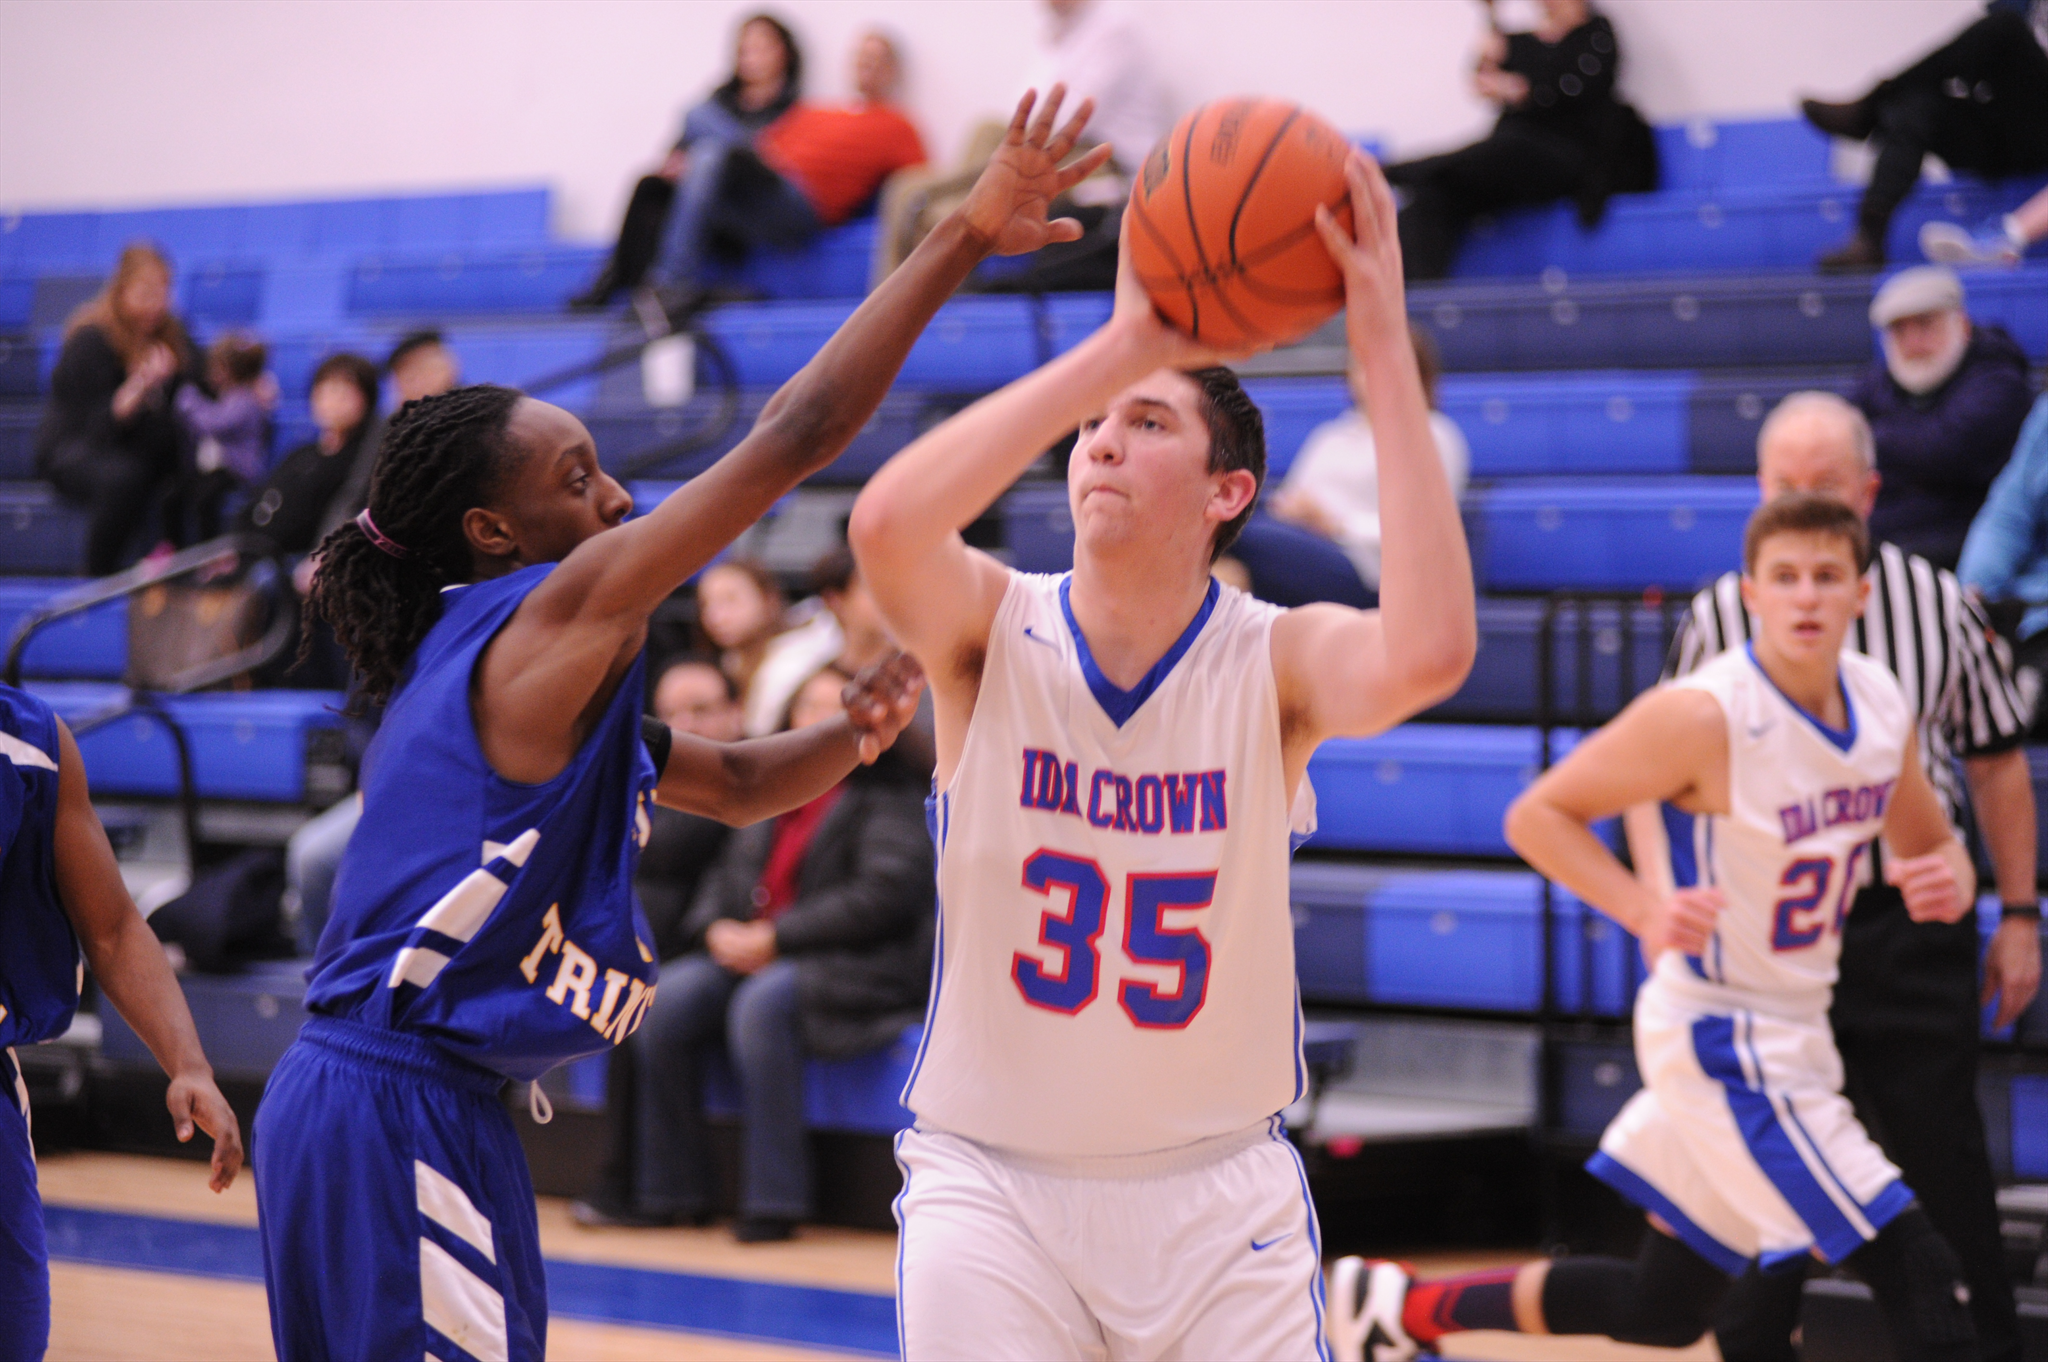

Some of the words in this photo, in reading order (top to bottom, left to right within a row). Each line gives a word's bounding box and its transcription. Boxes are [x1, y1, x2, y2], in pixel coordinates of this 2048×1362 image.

[1020, 746, 1083, 819] IDA
[1086, 767, 1228, 834] CROWN
[1010, 846, 1220, 1031] 35
